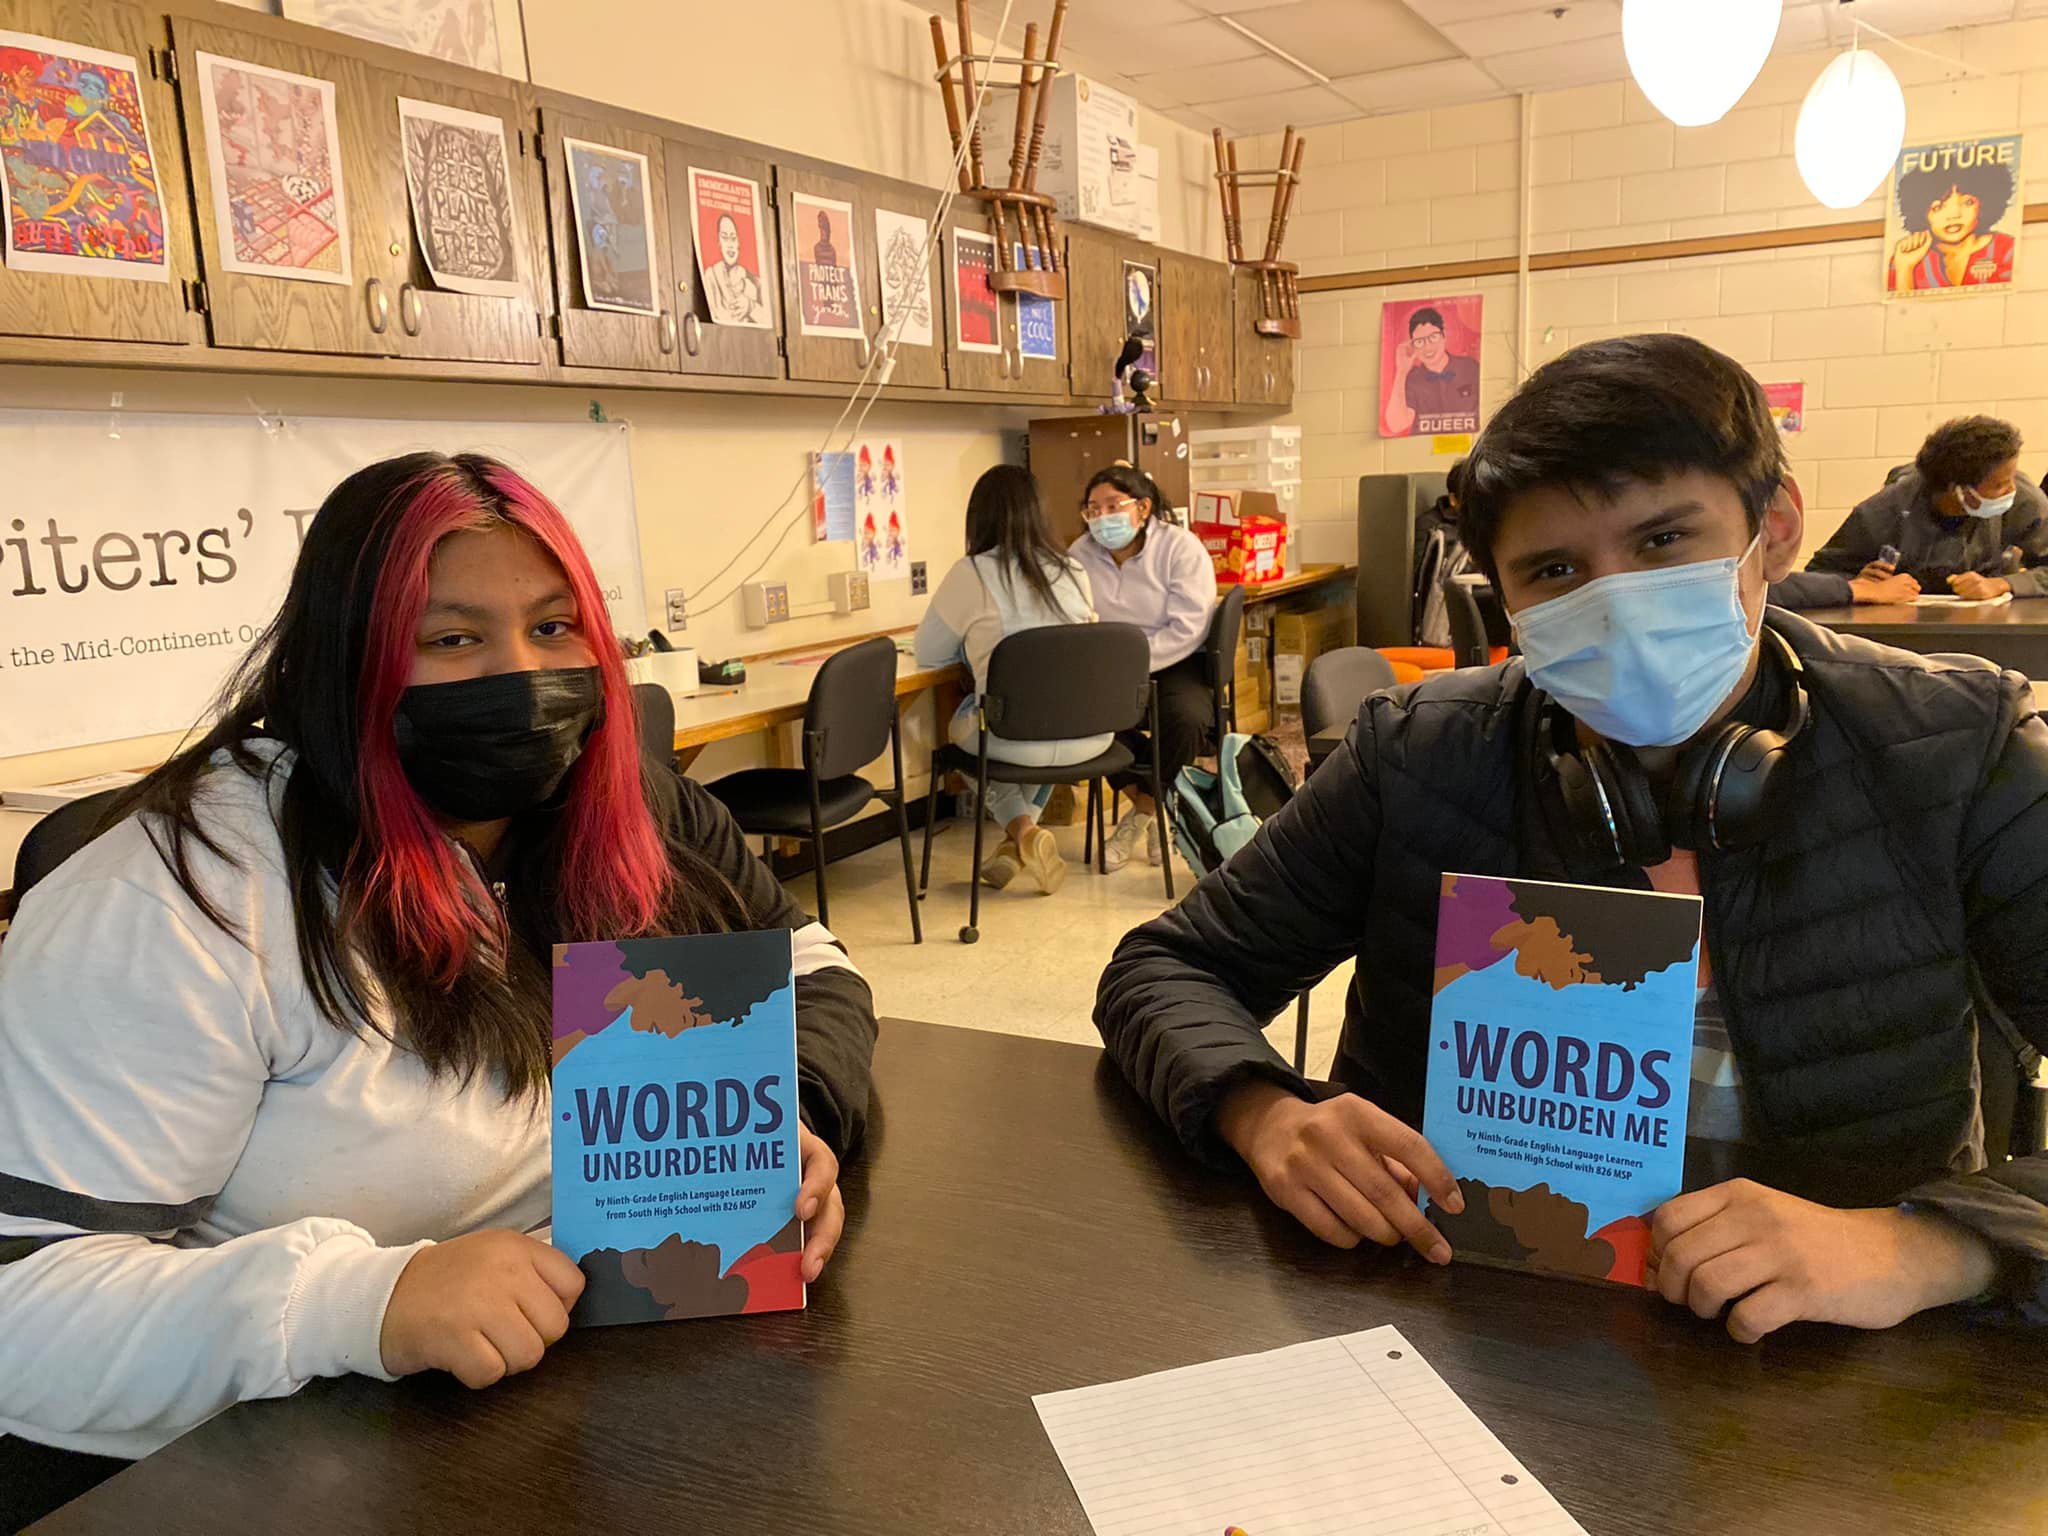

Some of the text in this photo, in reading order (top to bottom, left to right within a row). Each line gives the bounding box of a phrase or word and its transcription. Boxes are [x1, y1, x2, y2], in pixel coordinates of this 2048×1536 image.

[1902, 142, 2015, 173] FUTURE
[434, 160, 486, 195] PEACE
[434, 187, 488, 227] PLANT
[434, 228, 499, 267] TREES
[809, 263, 846, 283] PROTECT
[810, 282, 848, 302] TRANS
[1419, 417, 1476, 432] QUEER
[0, 507, 253, 596] iters'
[10, 647, 55, 667] the
[62, 626, 233, 663] Mid-Continent
[1453, 1020, 1672, 1109] WORDS
[574, 1075, 783, 1146] WORDS
[1456, 1085, 1669, 1148] UNBURDEN ME
[583, 1140, 785, 1183] UNBURDEN ME
[1466, 1129, 1643, 1169] by Ninth-Grade English Language Learners
[1476, 1144, 1633, 1181] from South High School with 826 MSP
[595, 1186, 766, 1208] by Ninth-Grade English Language Learners
[606, 1199, 757, 1220] from South High School with 826 MSP
